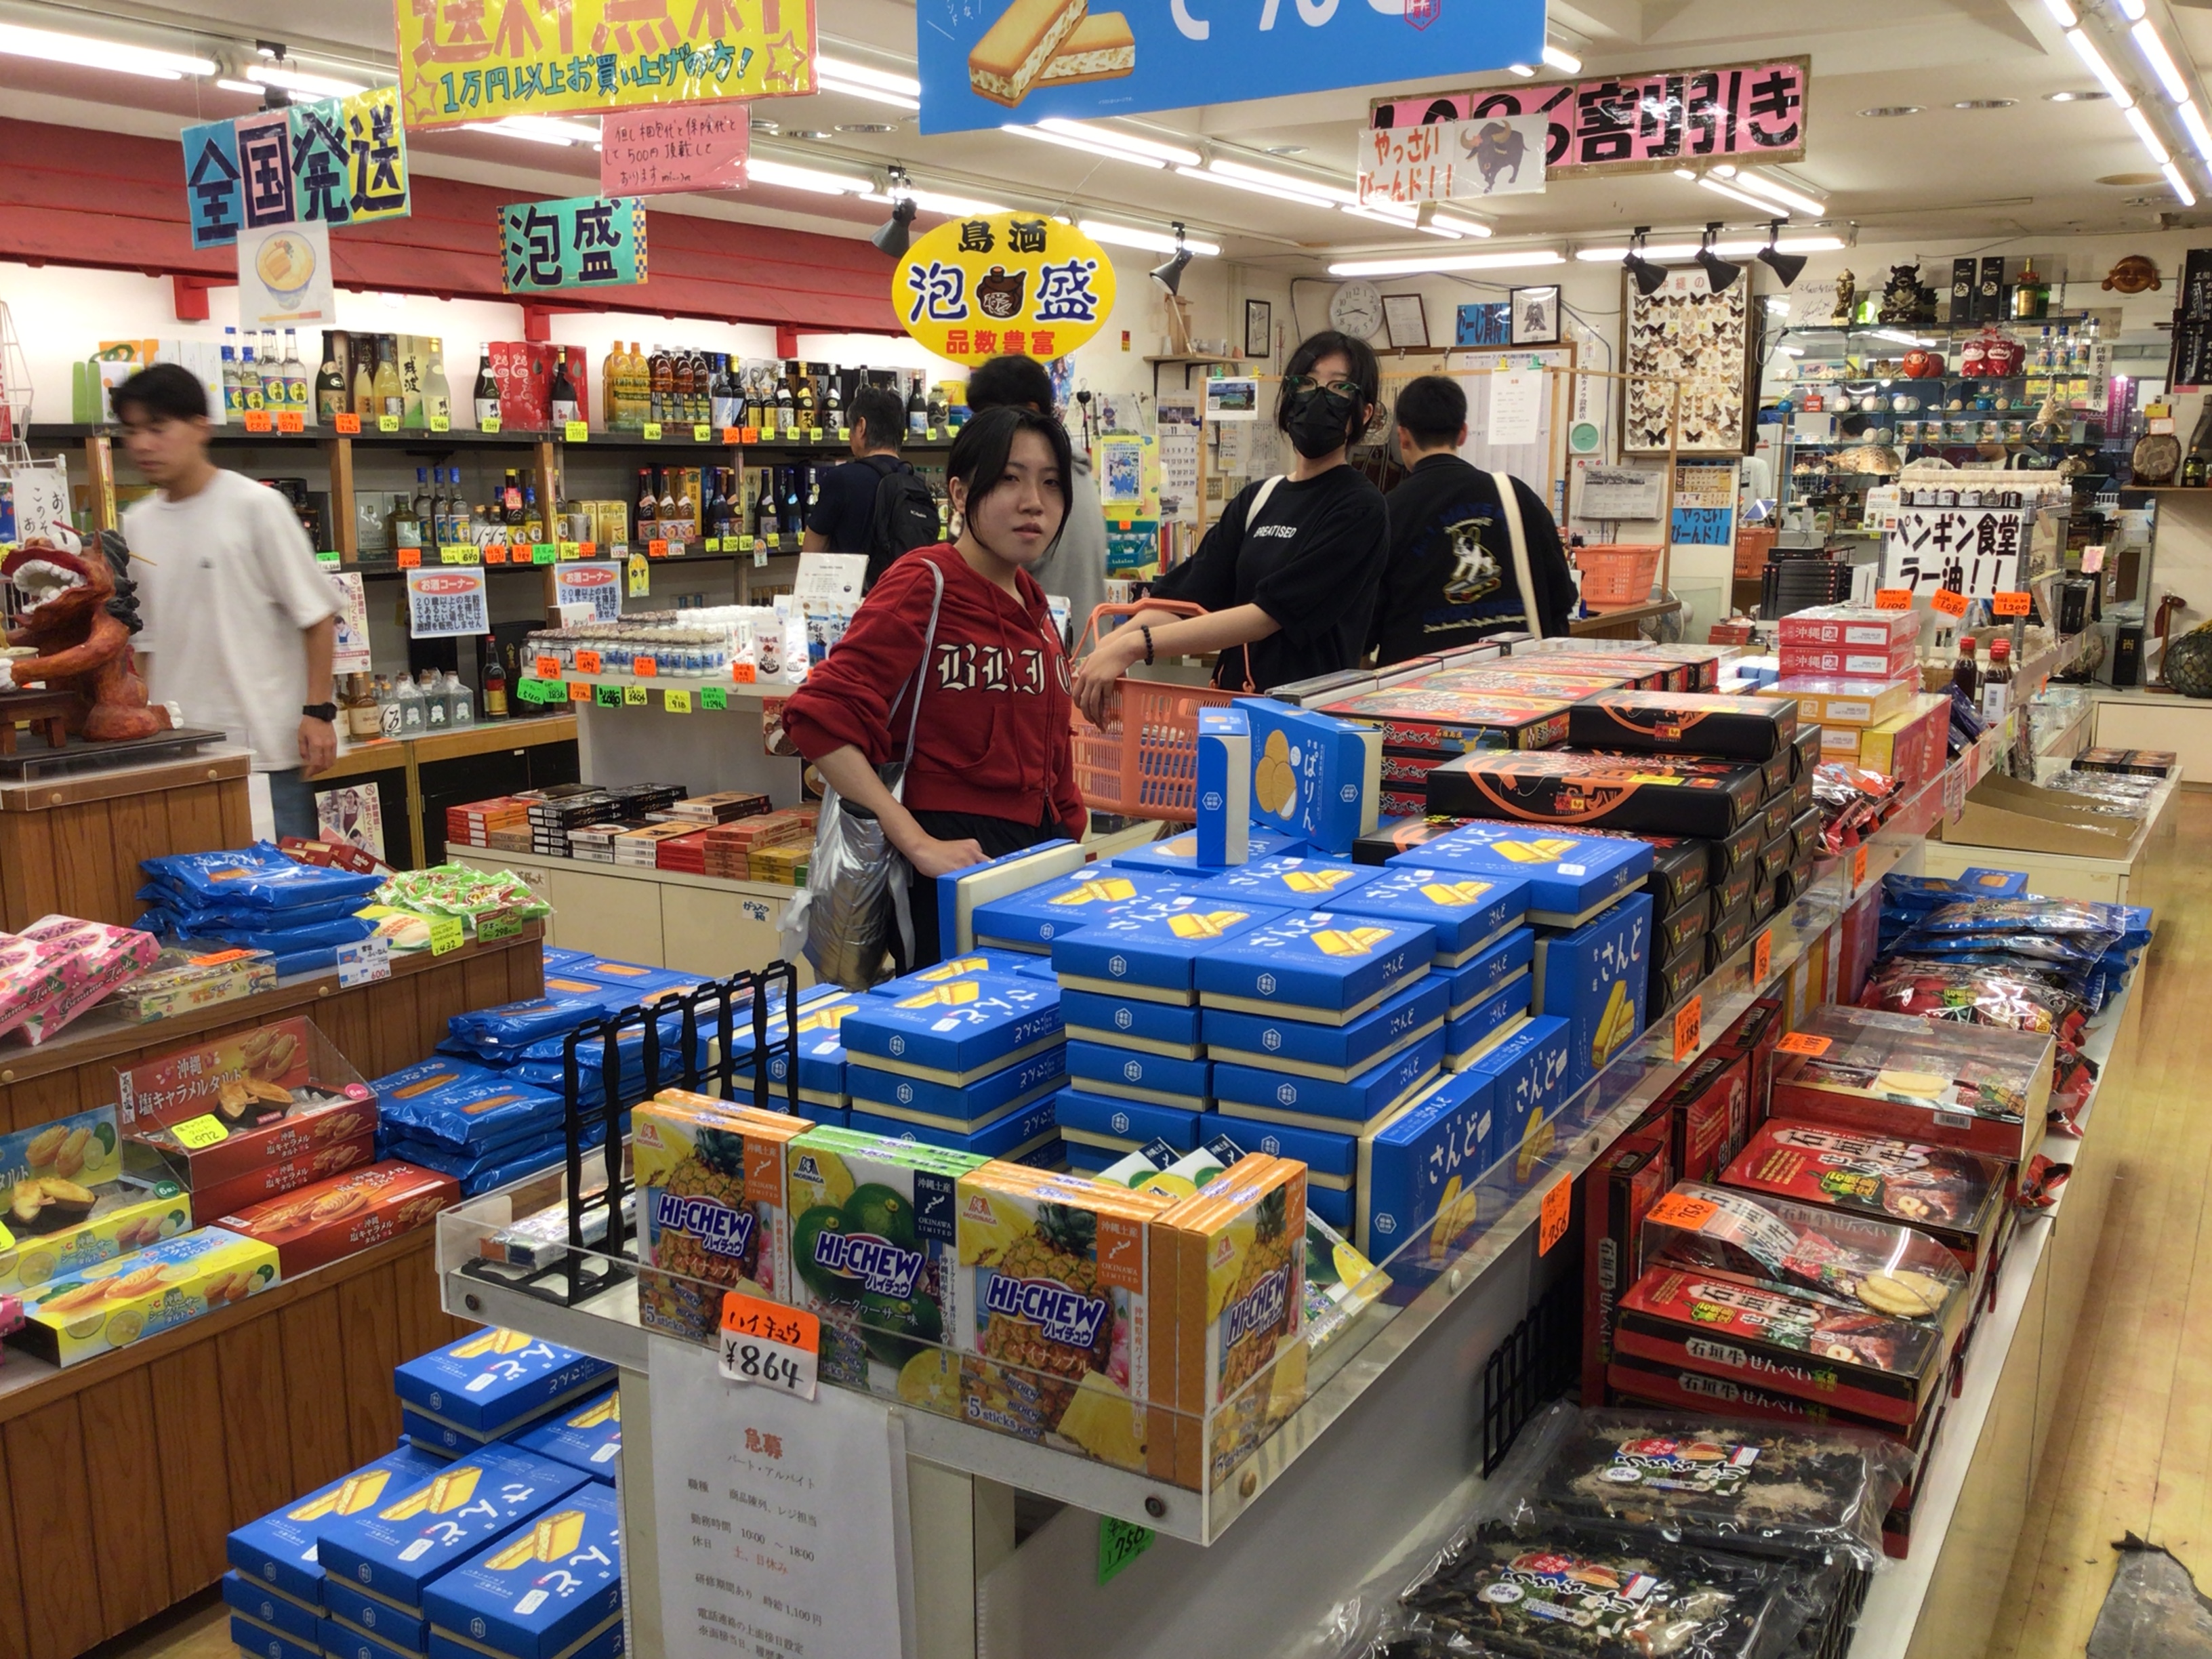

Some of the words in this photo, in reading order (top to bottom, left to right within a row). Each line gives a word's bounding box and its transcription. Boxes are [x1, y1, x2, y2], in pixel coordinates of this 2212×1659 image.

[1374, 125, 1439, 167] やっさい
[188, 104, 406, 243] 全国発送
[510, 199, 621, 287] 泡盛
[958, 218, 1047, 255] 島酒
[908, 260, 1099, 323] 泡盛
[946, 330, 1055, 355] 品数豊富
[2092, 346, 2105, 409] 防犯カメラ設置店
[1890, 513, 2020, 556] ペンギン食堂
[420, 577, 474, 592] お酒コーナー
[565, 571, 611, 584] お酒コーナー
[1796, 626, 1821, 639] 沖縄
[1796, 655, 1821, 668] 沖縄
[1303, 752, 1319, 832] ぱりん
[1601, 914, 1643, 982] さんど
[178, 1054, 202, 1078] 沖縄
[1516, 1048, 1558, 1113] さんど
[138, 1070, 243, 1117] 塩キャラメルタルト
[266, 1134, 311, 1155] 塩キャラメル
[636, 1138, 665, 1150] MORINAGA
[1429, 1112, 1478, 1185] さんど
[1788, 1130, 1919, 1162] 石垣牛
[792, 1171, 825, 1185] MORINAGA
[917, 1176, 952, 1194] 沖縄土産
[349, 1221, 394, 1242] 塩キャラメル
[657, 1193, 754, 1242] HI-CHEW
[918, 1216, 952, 1230] OKINAWA
[918, 1225, 952, 1237] LIMITED
[962, 1210, 998, 1227] MORINAGA
[1100, 1219, 1139, 1239] 沖縄土産
[703, 1235, 745, 1256] ハイチュウ
[815, 1230, 925, 1282] HI-CHEW
[677, 1256, 743, 1280] パイナップル
[1101, 1261, 1139, 1275] OKINAWA
[1101, 1270, 1139, 1284] LIMITED
[865, 1274, 911, 1296] ハイチュウ
[986, 1271, 1108, 1330] HI-CHEW
[645, 1305, 656, 1322] 5
[1226, 1263, 1290, 1347] HI-CHEW
[1700, 1286, 1814, 1319] 石垣牛
[729, 1313, 802, 1344] ハイチュウ
[1042, 1319, 1093, 1346] ハイチュウ
[726, 1339, 804, 1390] ¥864
[1691, 1338, 1813, 1381] 石垣牛せんべい
[1683, 1373, 1805, 1416] 石垣牛せんべい
[967, 1395, 981, 1418] 5
[982, 1409, 1017, 1431] sticks
[745, 1427, 784, 1460] 急募
[727, 1454, 816, 1489] パート・アルバイト
[687, 1477, 710, 1494] 職種
[729, 1488, 818, 1528] 商品陳列、レジ担当
[691, 1513, 732, 1534] 勤務時間
[741, 1528, 766, 1546] 10:00
[789, 1546, 815, 1562] 18:00
[692, 1535, 713, 1550] 休日
[695, 1572, 754, 1601] 研修期間あり
[763, 1595, 783, 1612] 時給
